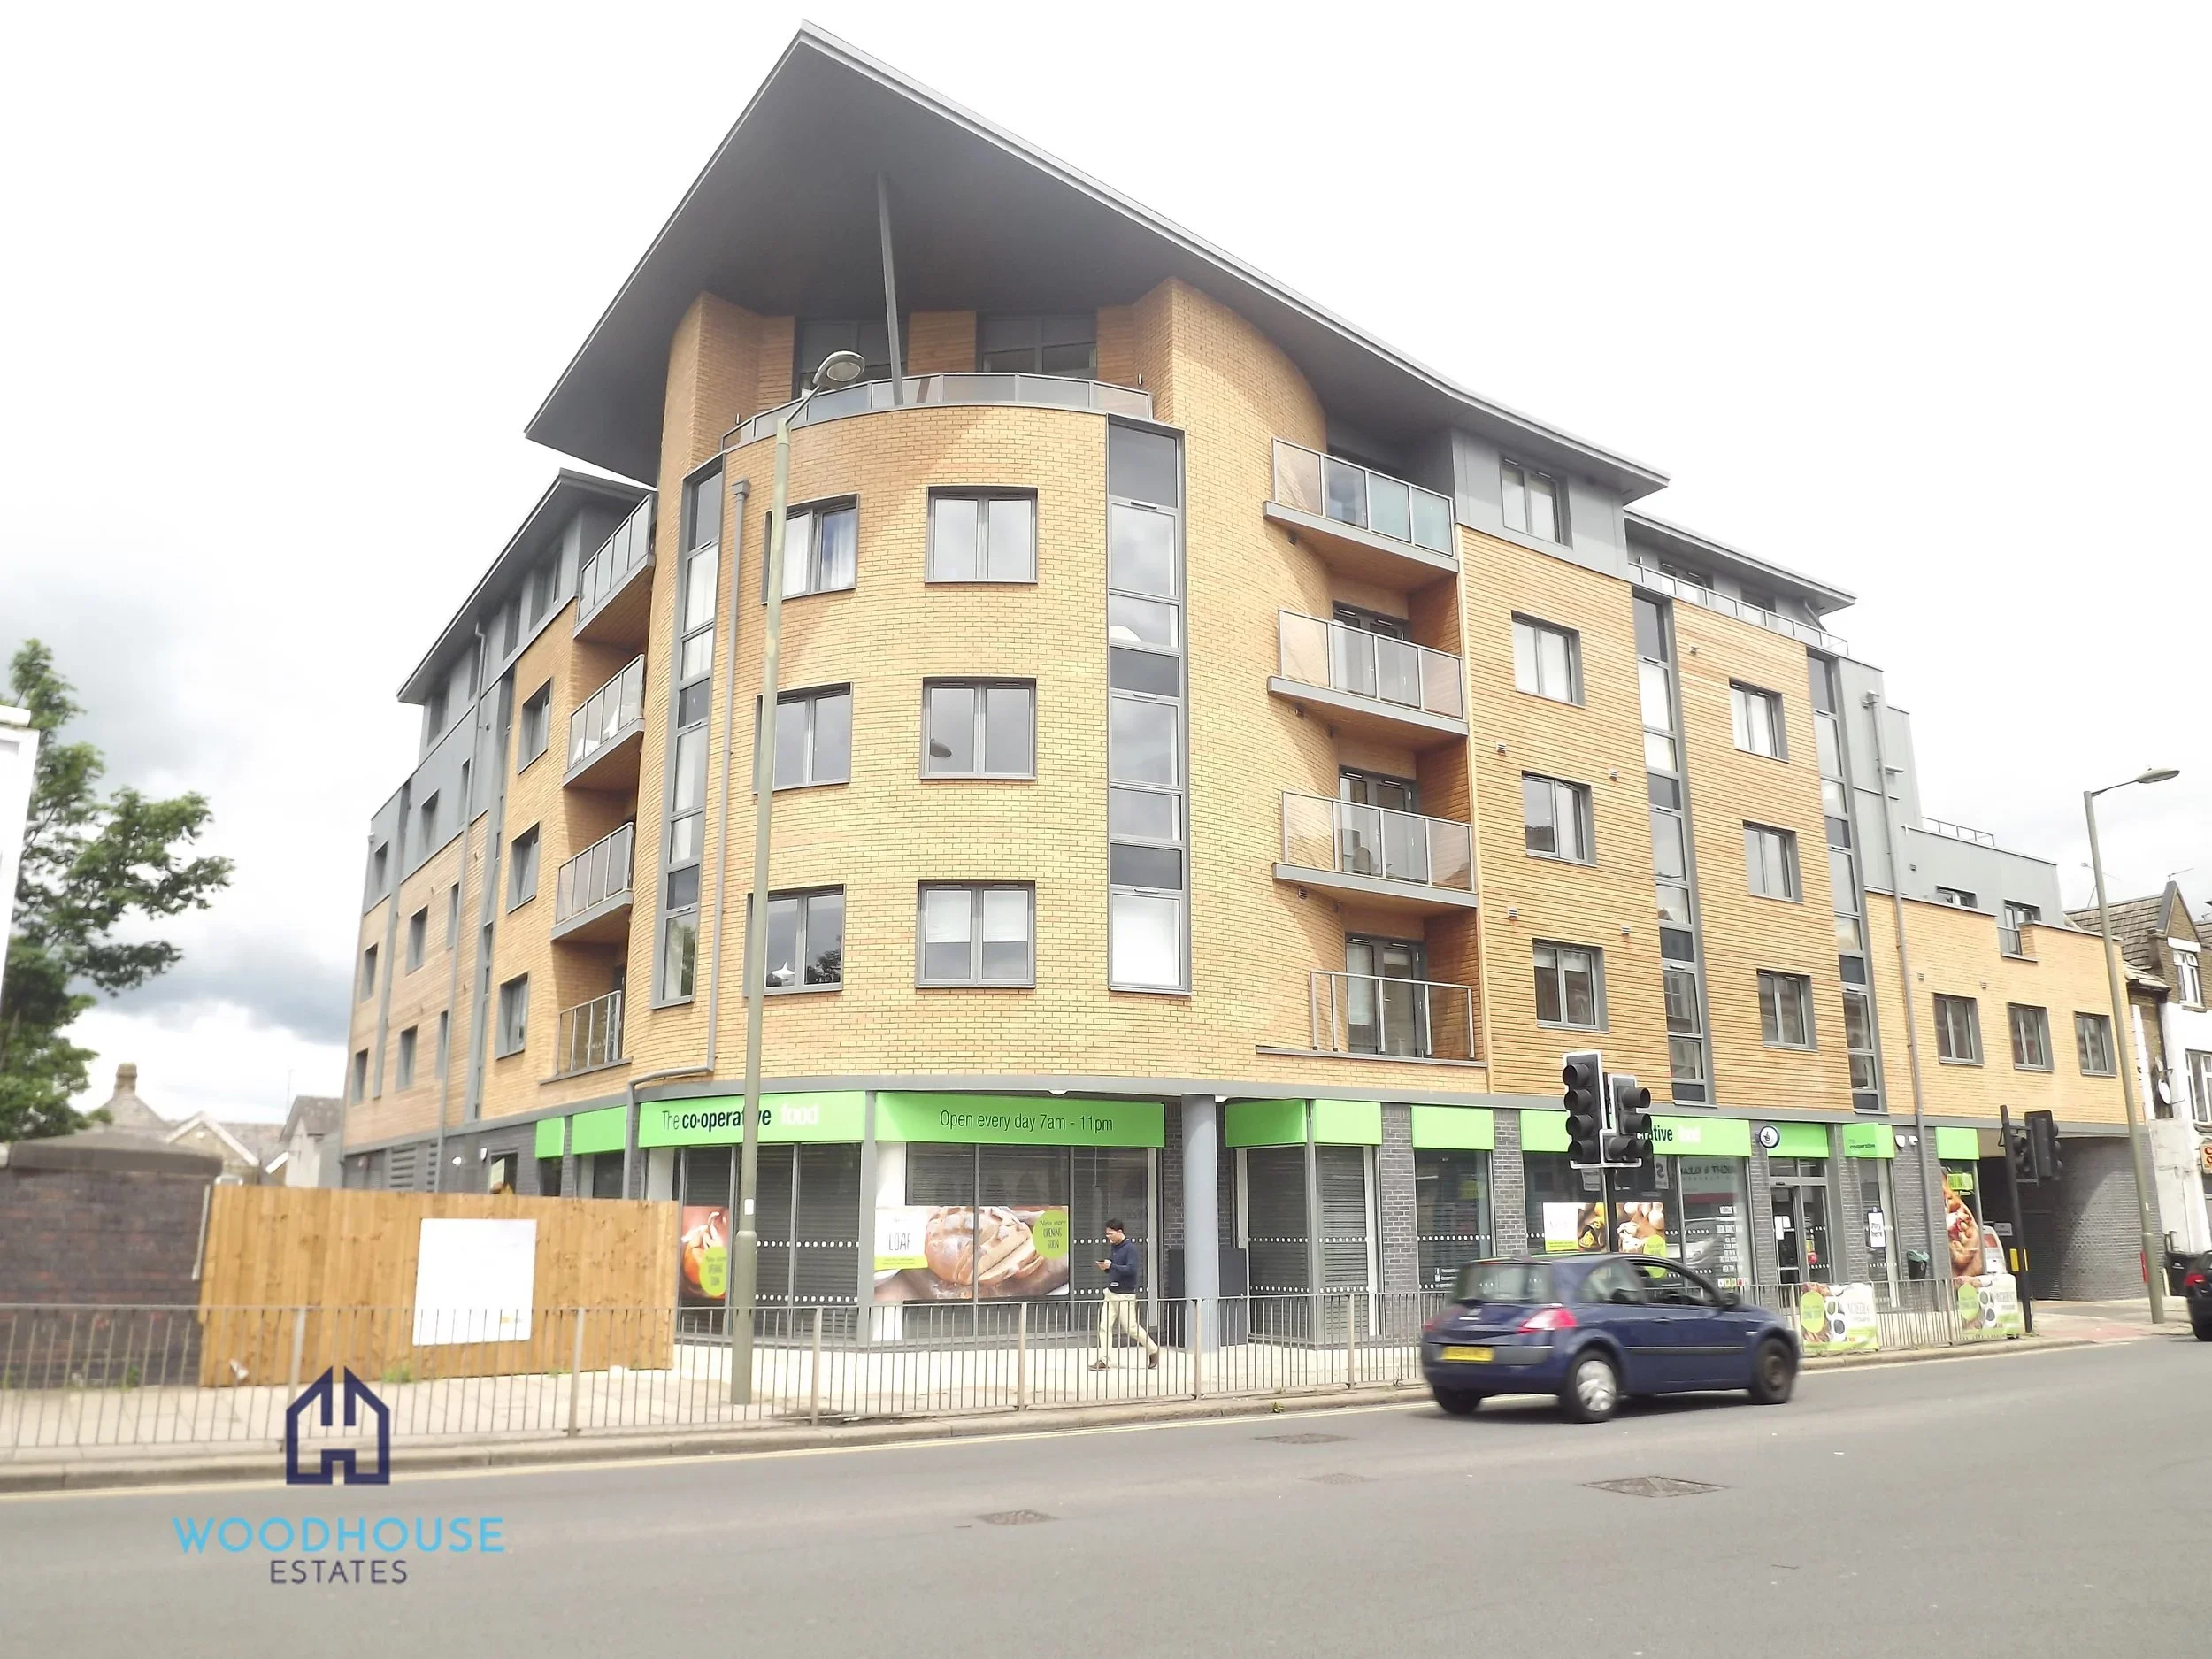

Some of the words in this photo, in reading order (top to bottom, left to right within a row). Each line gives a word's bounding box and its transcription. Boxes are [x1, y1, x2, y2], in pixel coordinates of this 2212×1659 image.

[661, 1110, 680, 1131] The
[681, 1109, 772, 1133] co-operatve
[940, 1110, 973, 1130] Open
[977, 1114, 1010, 1132] every
[1014, 1112, 1036, 1133] day
[1040, 1113, 1066, 1131] 7am
[1079, 1115, 1114, 1133] 11pm
[888, 1232, 911, 1251] LOAF
